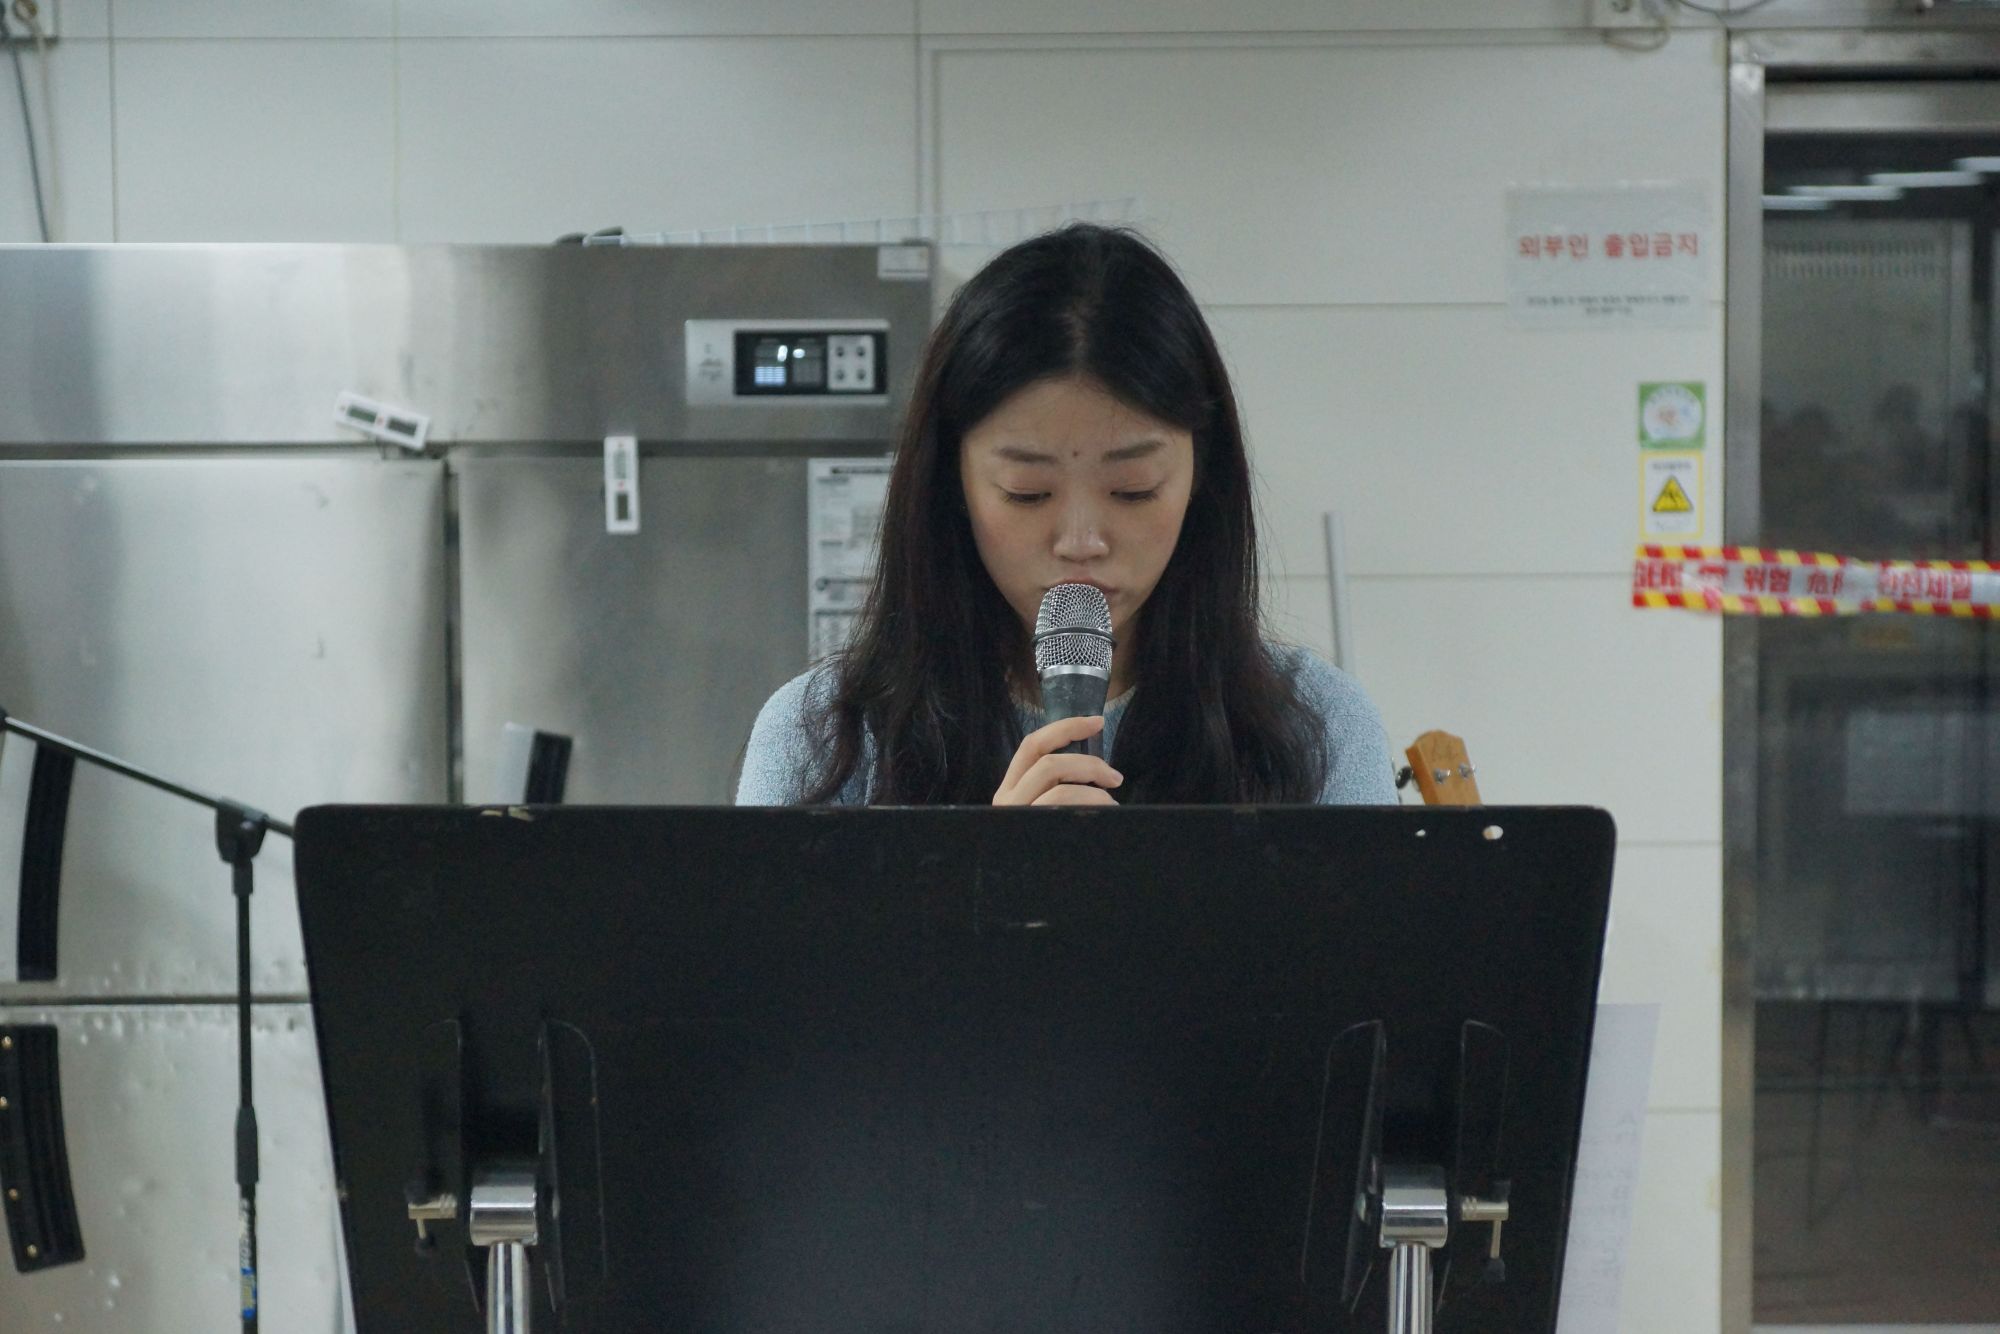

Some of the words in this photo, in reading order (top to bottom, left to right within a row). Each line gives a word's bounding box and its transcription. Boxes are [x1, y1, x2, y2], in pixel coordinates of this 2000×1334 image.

[1518, 234, 1589, 260] 외부인
[1604, 232, 1698, 259] 출입금지
[1743, 566, 1791, 593] 위험
